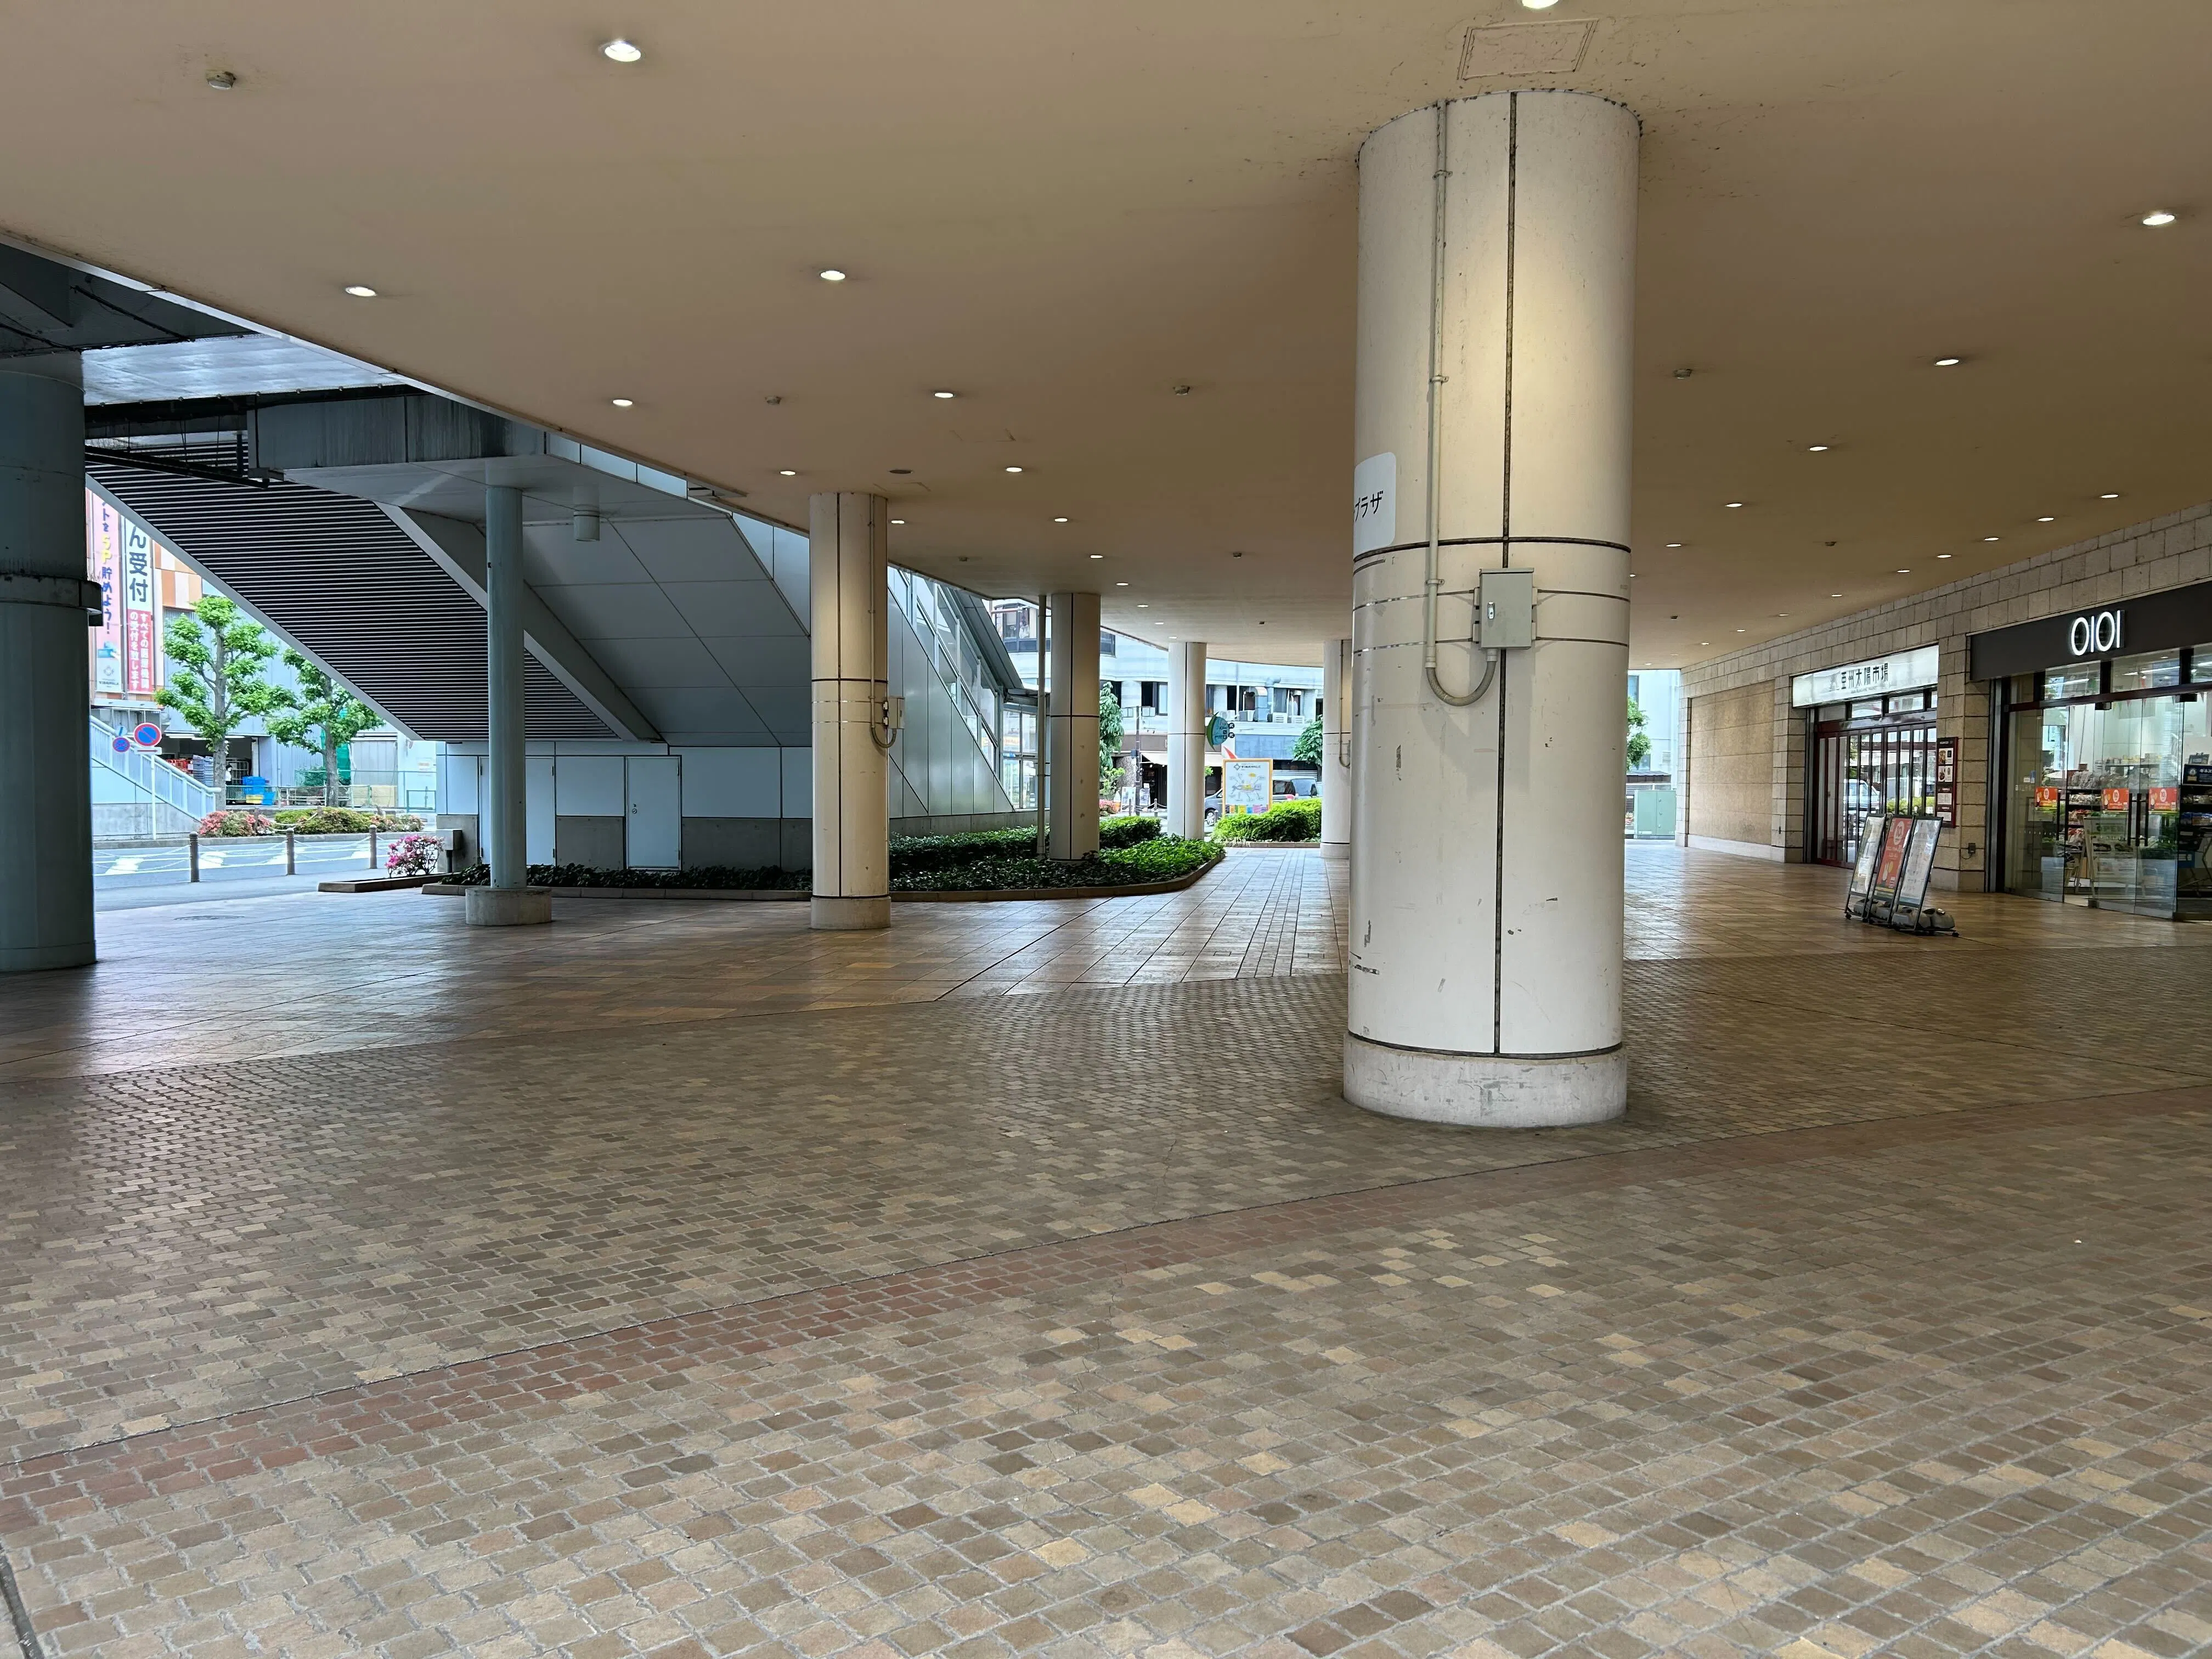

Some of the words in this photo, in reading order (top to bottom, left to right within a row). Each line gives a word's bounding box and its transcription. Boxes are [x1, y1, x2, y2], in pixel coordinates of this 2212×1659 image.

[1353, 490, 1384, 522] プラザ
[129, 526, 149, 602] ん受付
